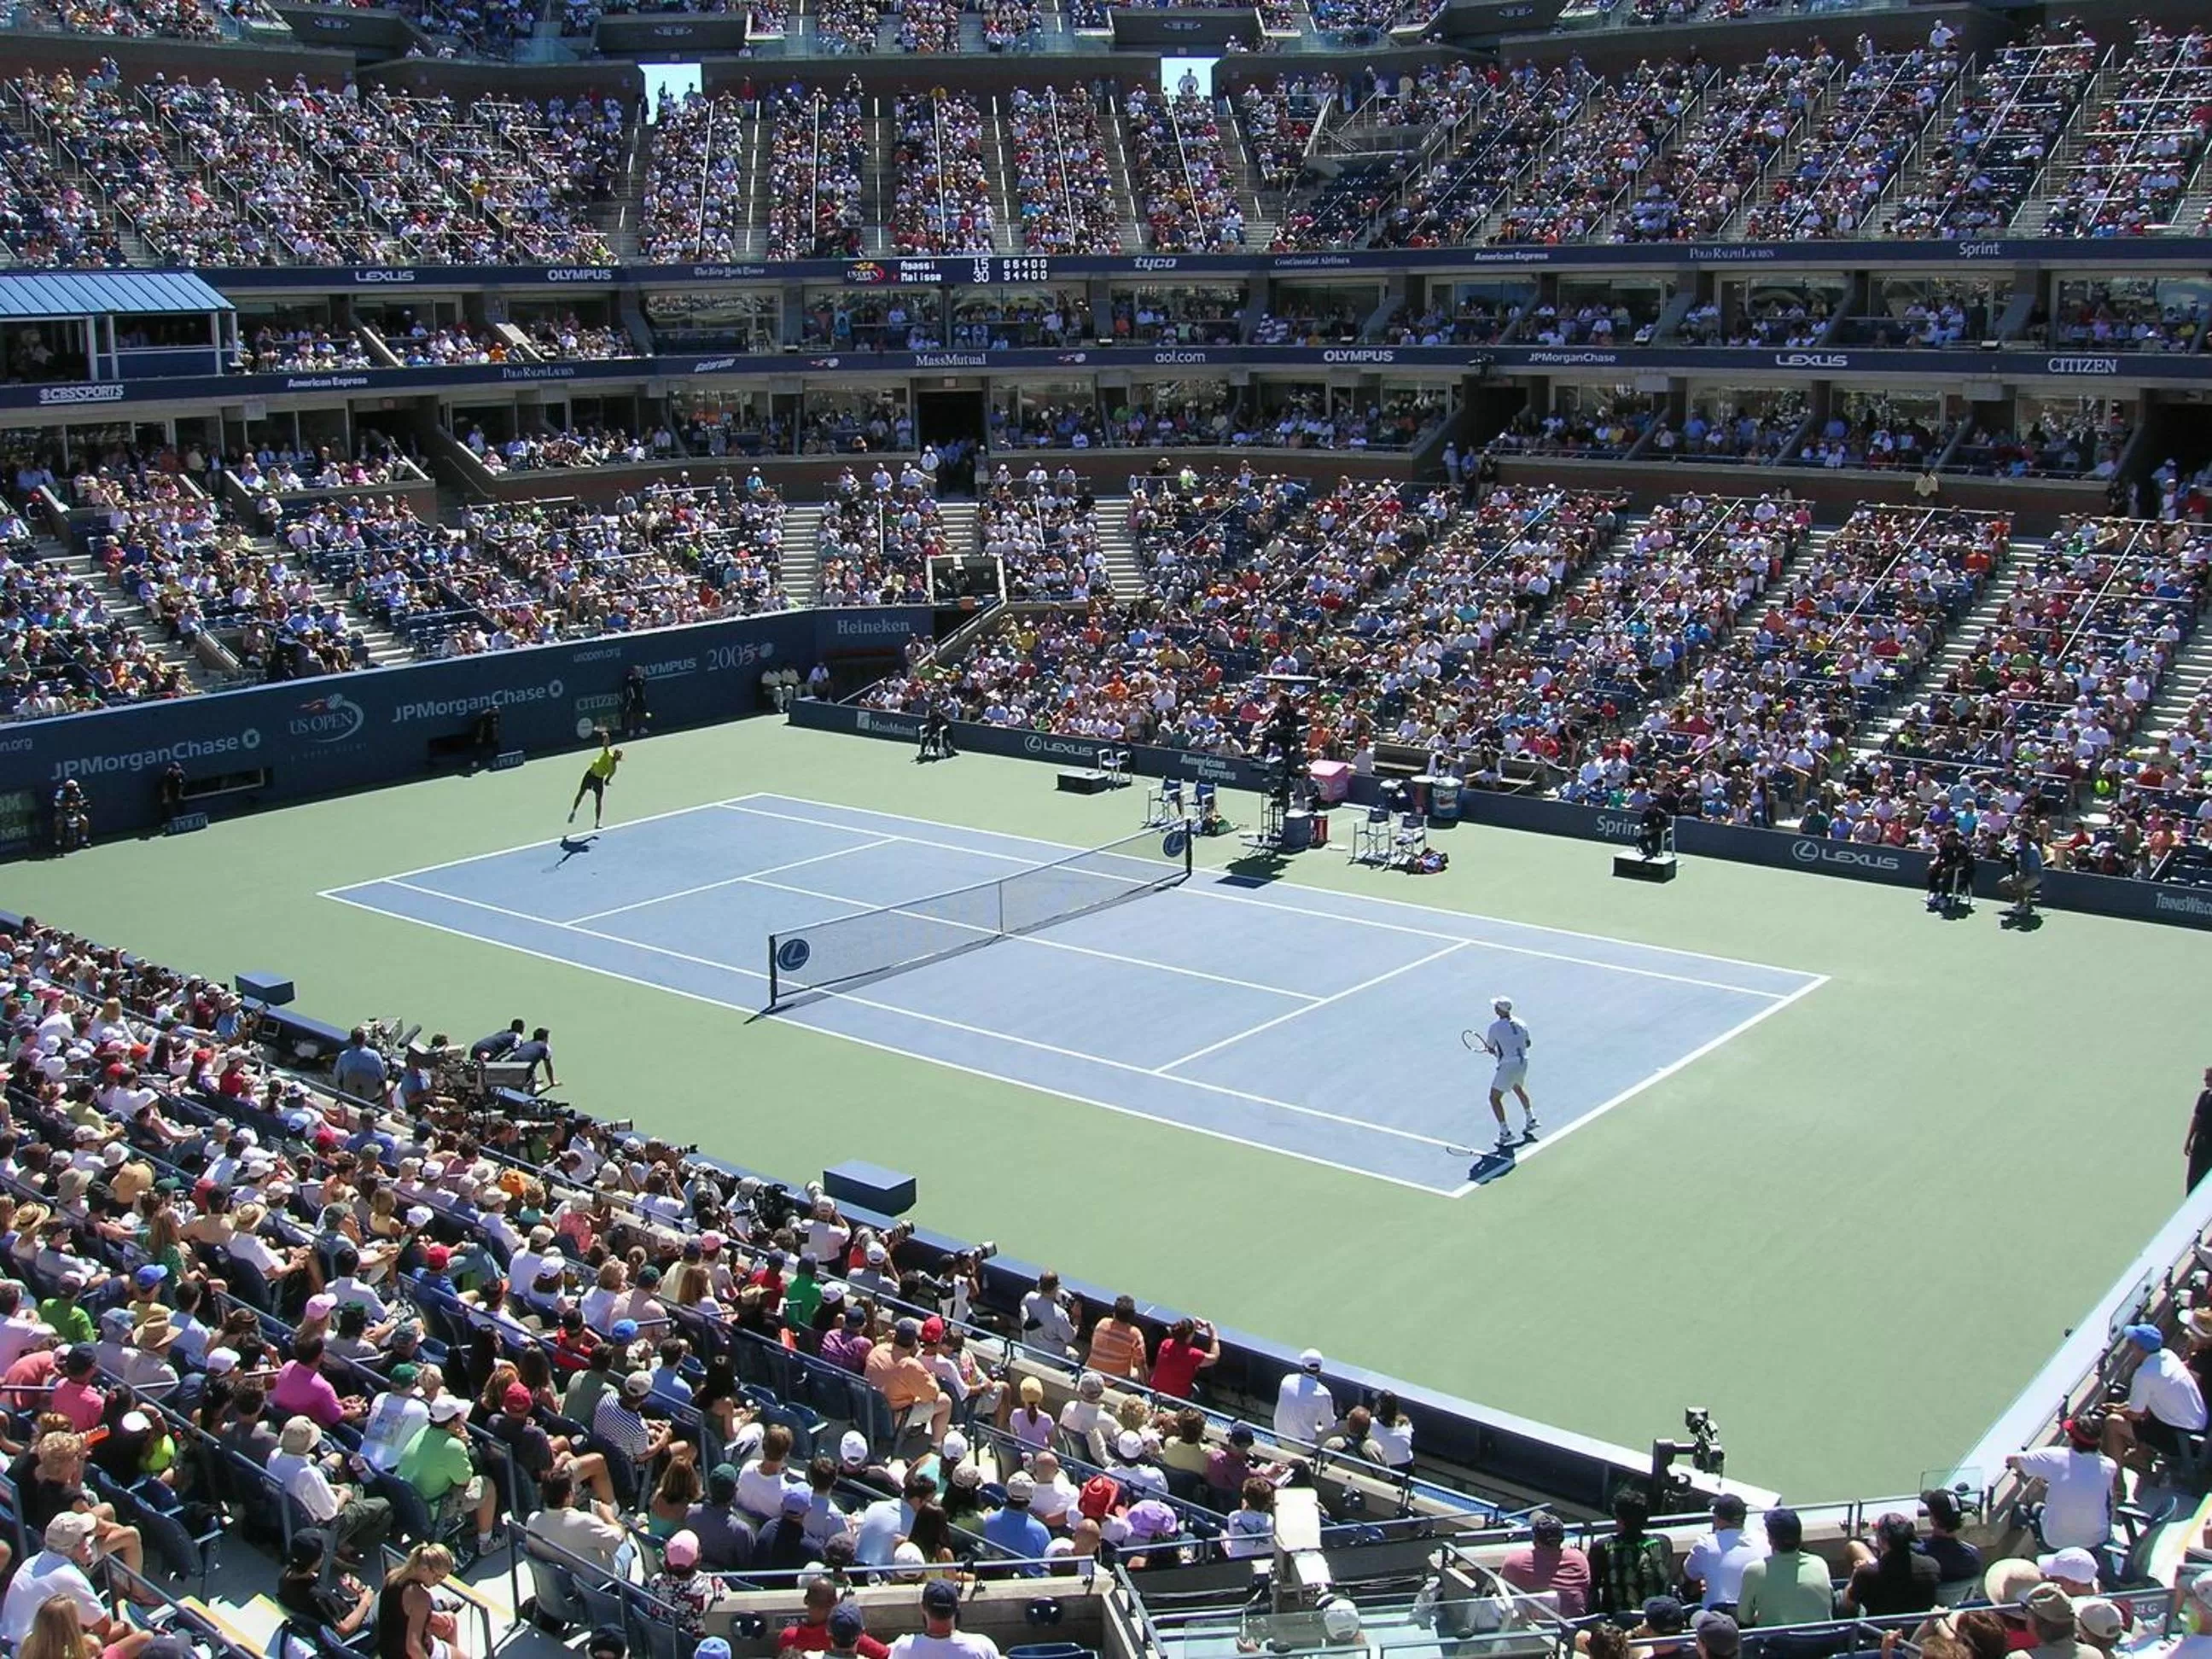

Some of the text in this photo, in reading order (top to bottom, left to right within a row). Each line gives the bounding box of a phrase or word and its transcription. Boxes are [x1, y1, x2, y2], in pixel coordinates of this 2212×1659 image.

[1475, 252, 1514, 261] American
[1959, 241, 2000, 258] Sprint
[974, 258, 989, 270] 15
[1134, 257, 1177, 271] tyco
[355, 271, 415, 282] LEXUS
[547, 269, 612, 282] OLYMPUS
[973, 270, 990, 282] 30
[916, 353, 987, 367] MassMutual
[1155, 349, 1206, 364] aol.com
[1323, 350, 1394, 363] OLYMPUS
[1528, 352, 1616, 364] JPMorganChase
[1776, 354, 1848, 367] LEXUS
[2048, 358, 2117, 374] CITIZEN
[288, 376, 368, 388] American Express
[836, 618, 911, 635] Heineken
[638, 658, 697, 677] LYMPUS
[392, 686, 546, 723] JPMorganChase
[577, 694, 623, 711] CITIZEN
[1044, 740, 1093, 756] LEXUS
[49, 736, 239, 780] JPMorganChase
[1180, 753, 1226, 769] American
[1197, 765, 1237, 781] Express
[1596, 814, 1640, 836] Sprin
[1822, 848, 1900, 870] LEXUS
